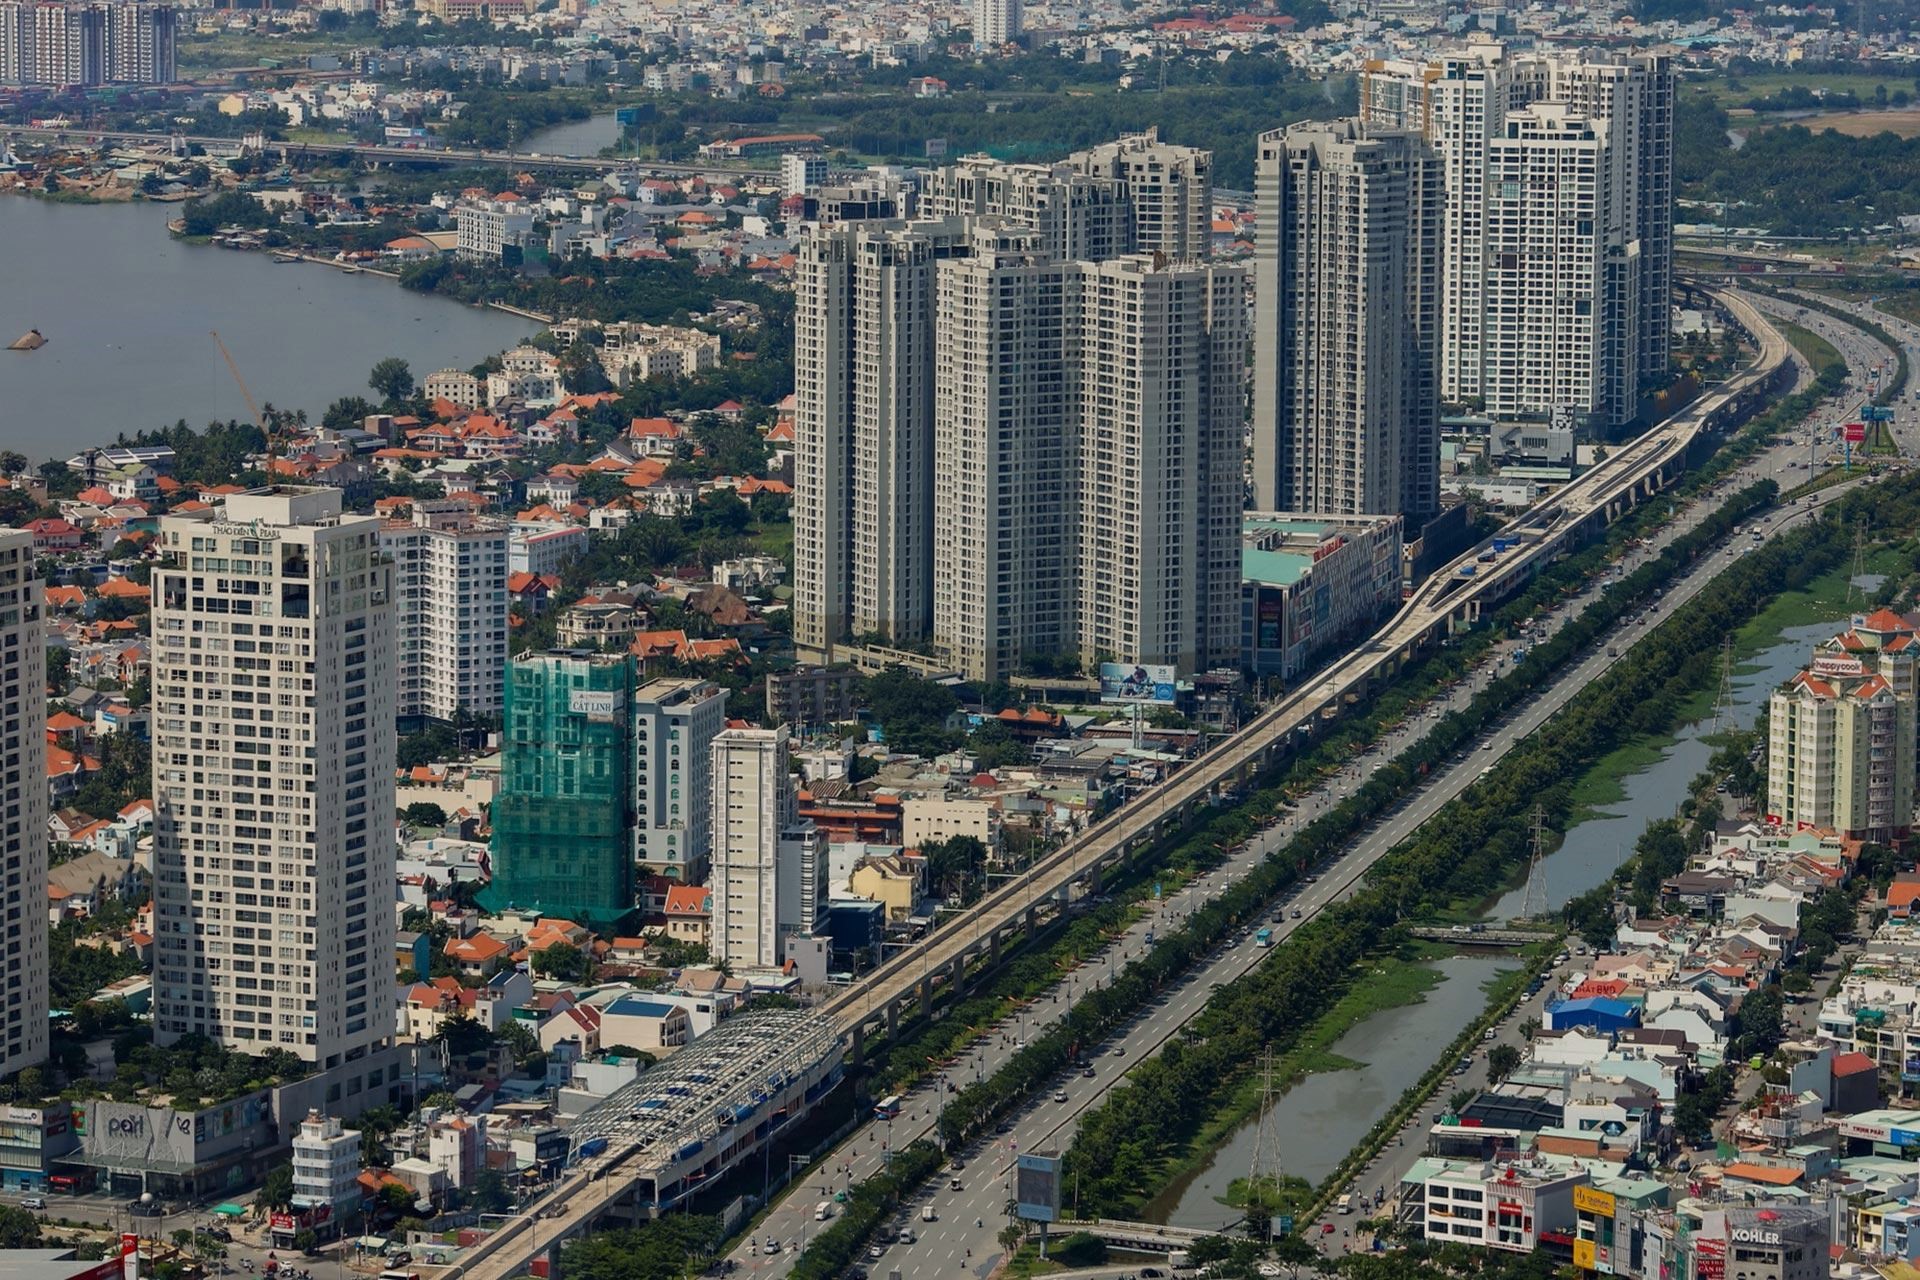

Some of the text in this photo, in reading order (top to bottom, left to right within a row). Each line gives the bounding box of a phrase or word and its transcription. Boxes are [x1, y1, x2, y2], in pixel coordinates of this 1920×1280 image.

[1815, 660, 1861, 671] happycook
[591, 702, 611, 712] LINH
[1732, 1229, 1779, 1244] KOHLER
